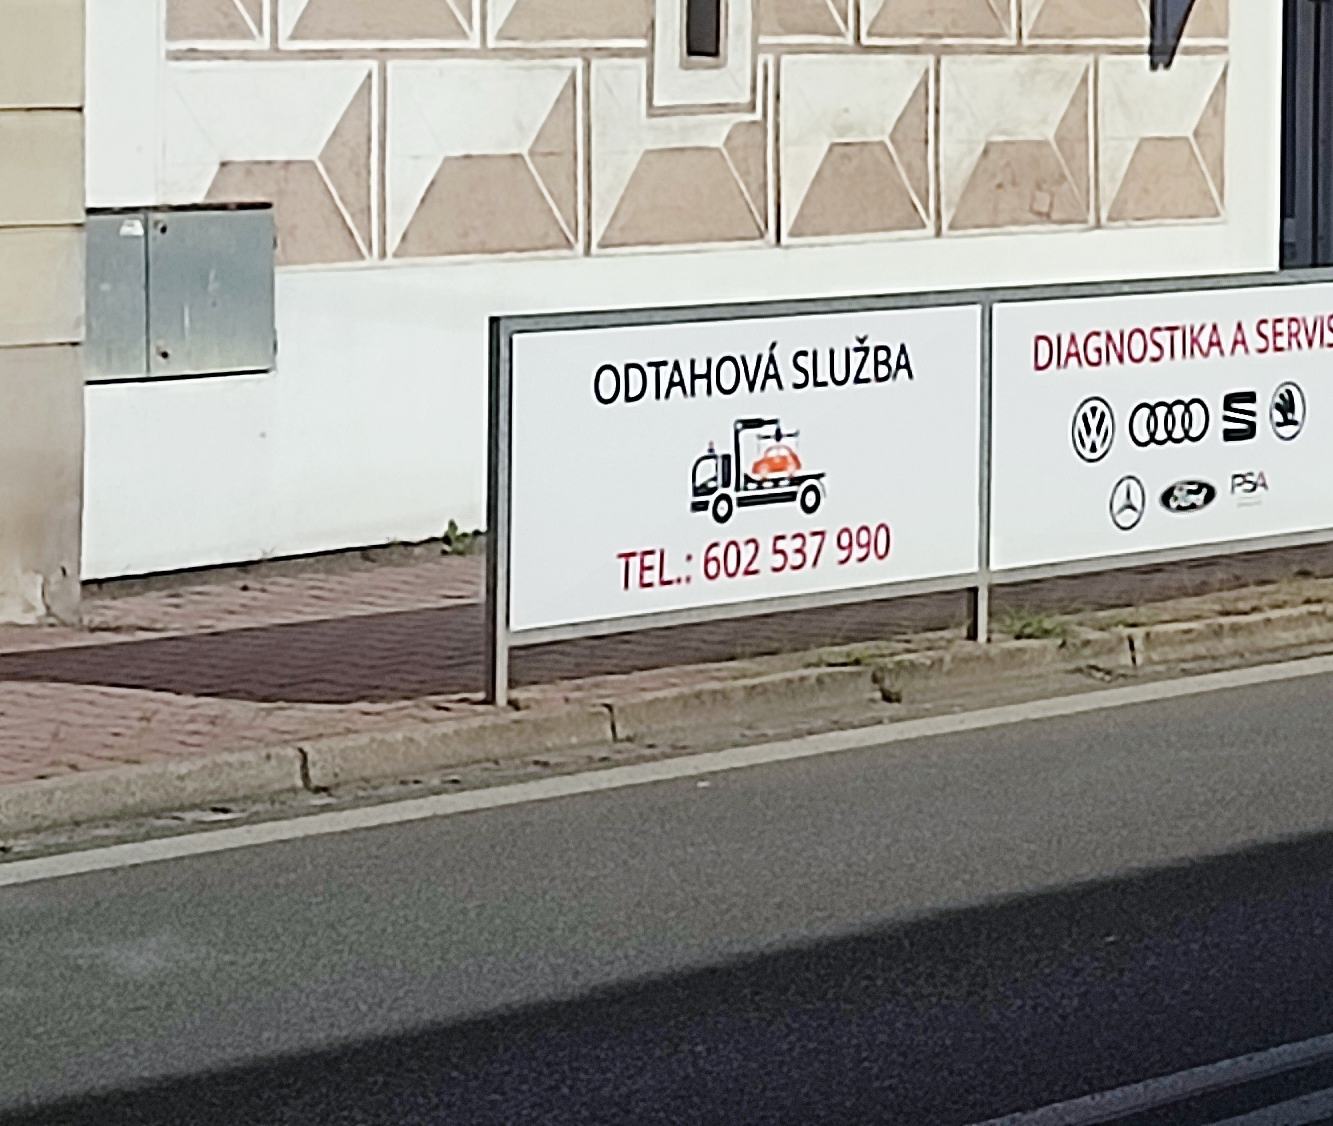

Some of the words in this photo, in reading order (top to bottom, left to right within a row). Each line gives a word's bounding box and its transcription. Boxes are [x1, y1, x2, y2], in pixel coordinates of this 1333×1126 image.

[593, 341, 785, 406] ODTAHOVÁ
[791, 335, 915, 390] SLUŽBA
[1033, 322, 1225, 372] DIAGNOSTIKA
[1229, 320, 1251, 356] A
[1230, 471, 1269, 496] PSA
[616, 548, 693, 591] TEL.:
[703, 538, 761, 581] 602
[770, 530, 827, 573] 537
[836, 522, 892, 566] 990
